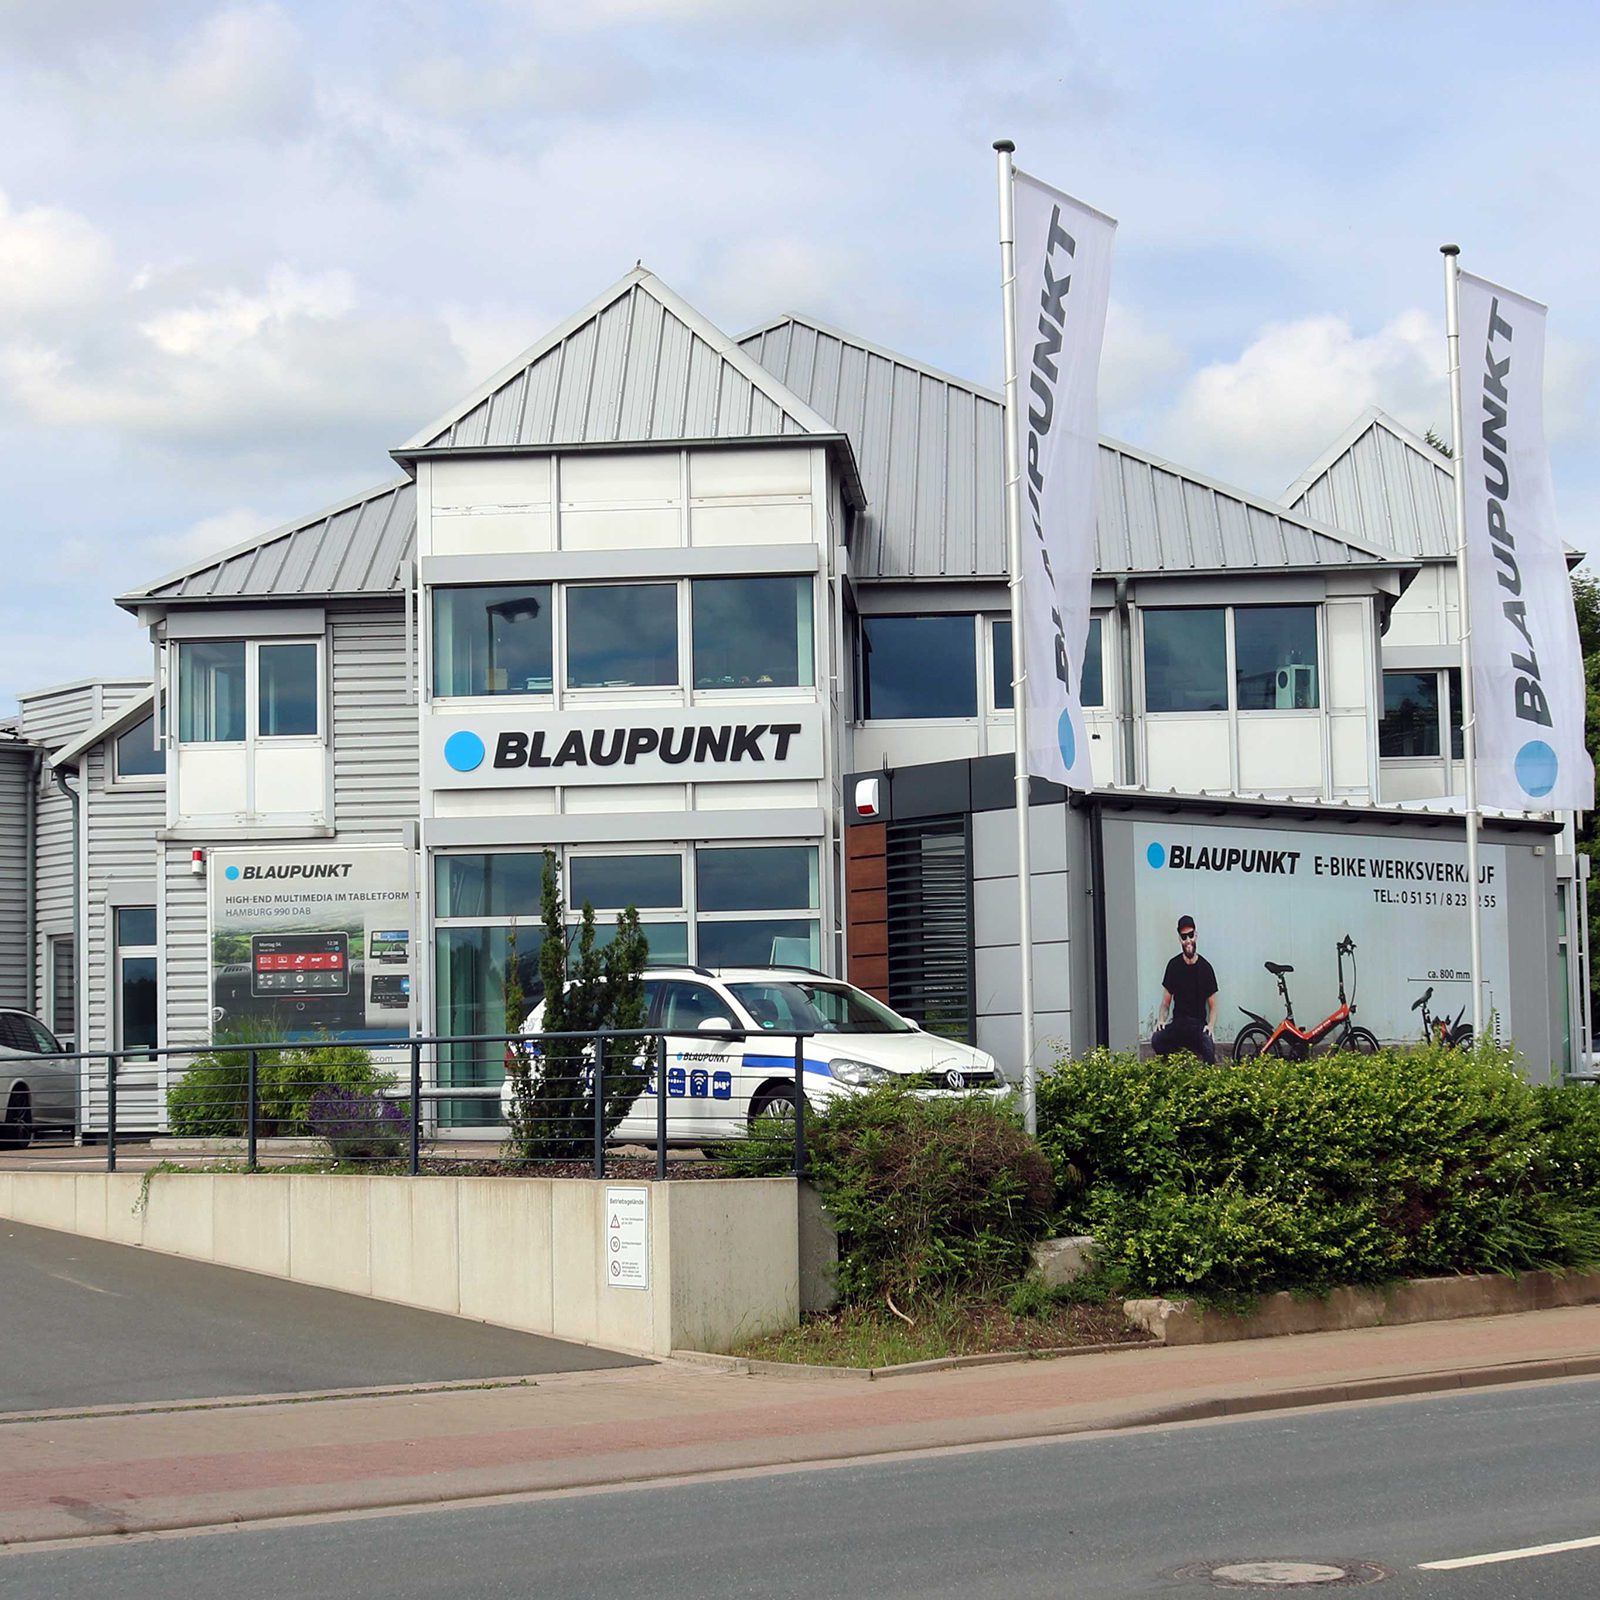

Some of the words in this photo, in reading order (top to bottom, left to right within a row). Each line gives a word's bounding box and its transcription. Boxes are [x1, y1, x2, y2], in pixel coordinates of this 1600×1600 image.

[1482, 296, 1554, 729] BLAUPUNKT
[493, 723, 802, 768] BLAUPUNKT
[1169, 845, 1301, 875] BLAUPUNKT
[1314, 855, 1367, 878] E-BIKE
[1370, 858, 1495, 884] WERKSVERKUF
[243, 863, 353, 880] BLAUPUNKT
[225, 894, 272, 904] HIGH-END
[274, 893, 334, 903] MULTIMEDIA
[335, 893, 347, 901] IM
[348, 891, 421, 901] TABLETFORMT
[1373, 889, 1400, 903] TEL.:
[1484, 895, 1496, 908] 55
[225, 908, 272, 917] HAMBURG
[274, 907, 290, 916] 990
[292, 906, 311, 916] DAB
[1427, 970, 1439, 979] ca.
[1440, 969, 1454, 979] 800
[1456, 971, 1471, 979] mm
